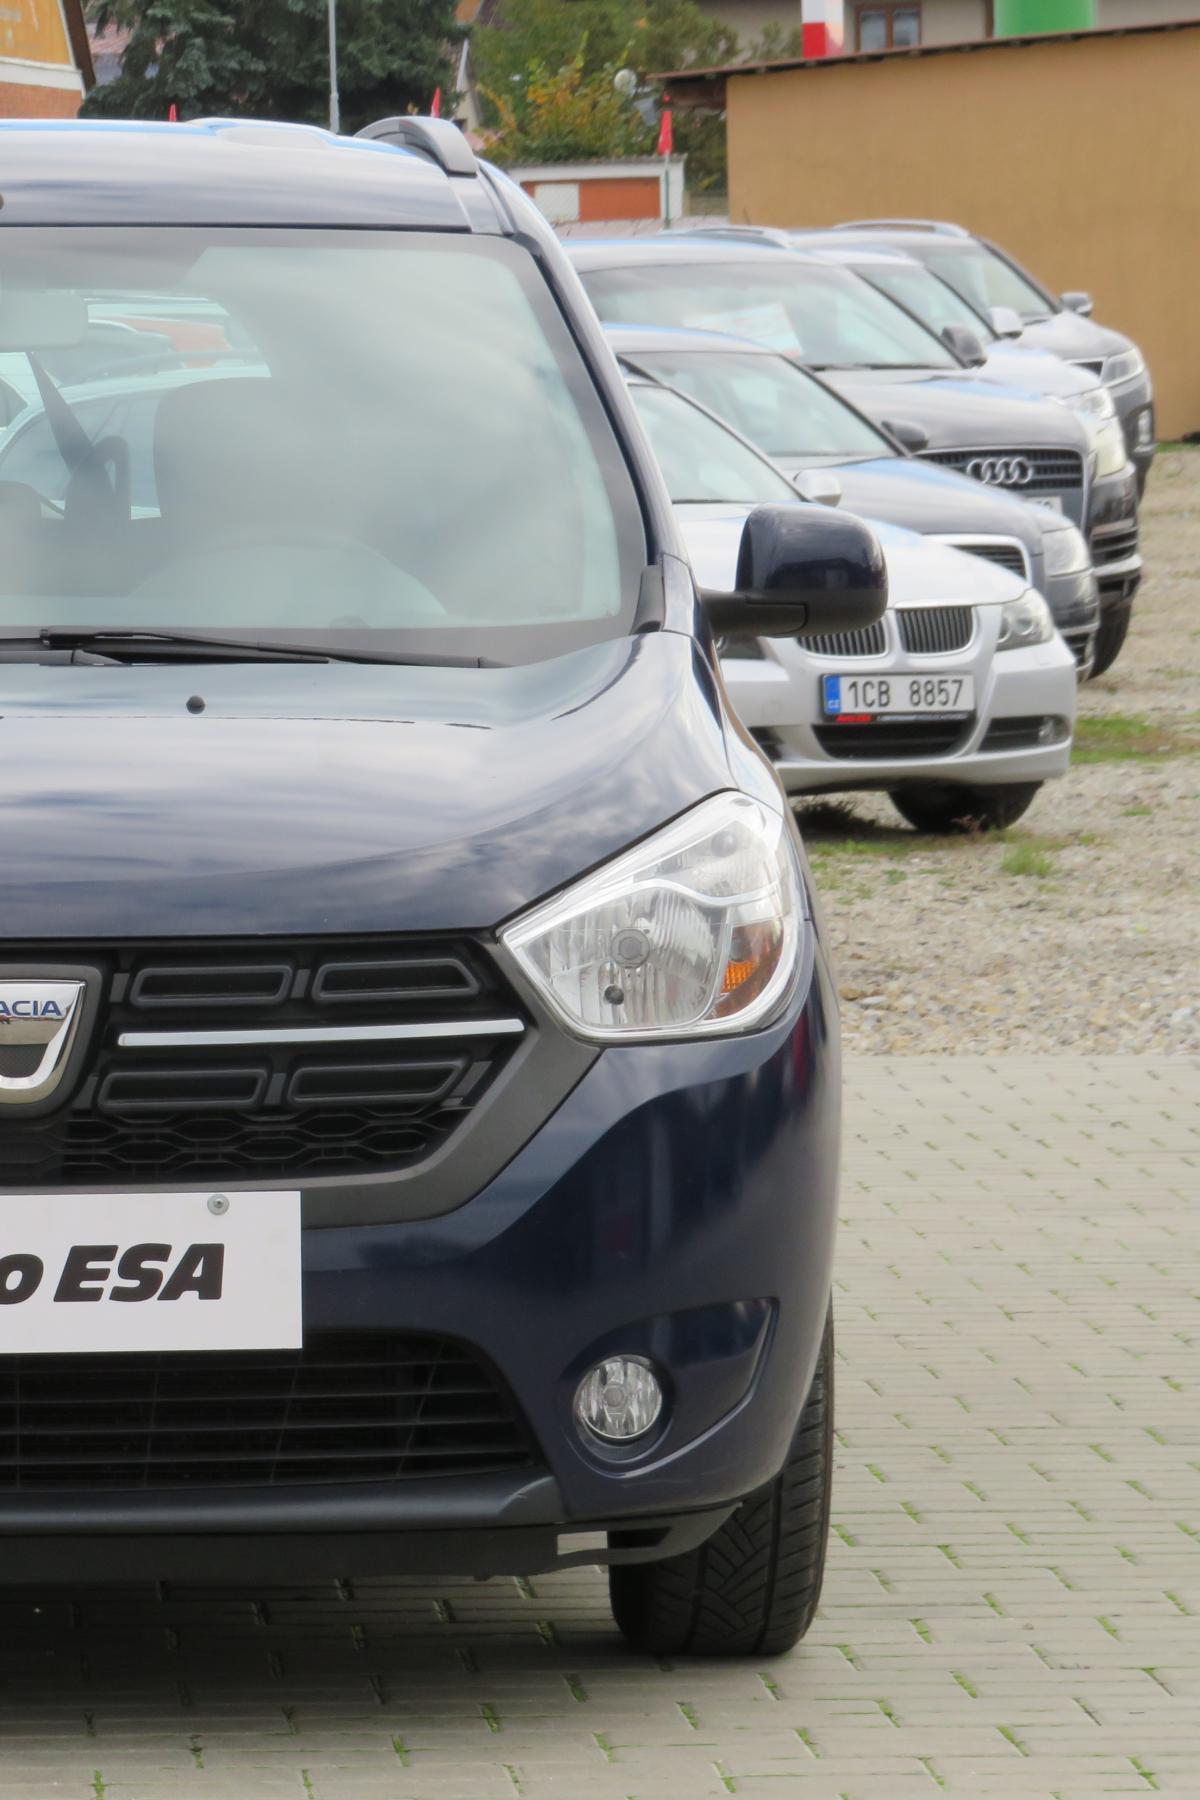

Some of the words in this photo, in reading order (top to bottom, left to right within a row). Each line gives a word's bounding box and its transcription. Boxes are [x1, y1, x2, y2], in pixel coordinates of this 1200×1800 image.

[848, 680, 891, 708] 1CB
[909, 679, 963, 706] 8857
[53, 1243, 225, 1303] ESA
